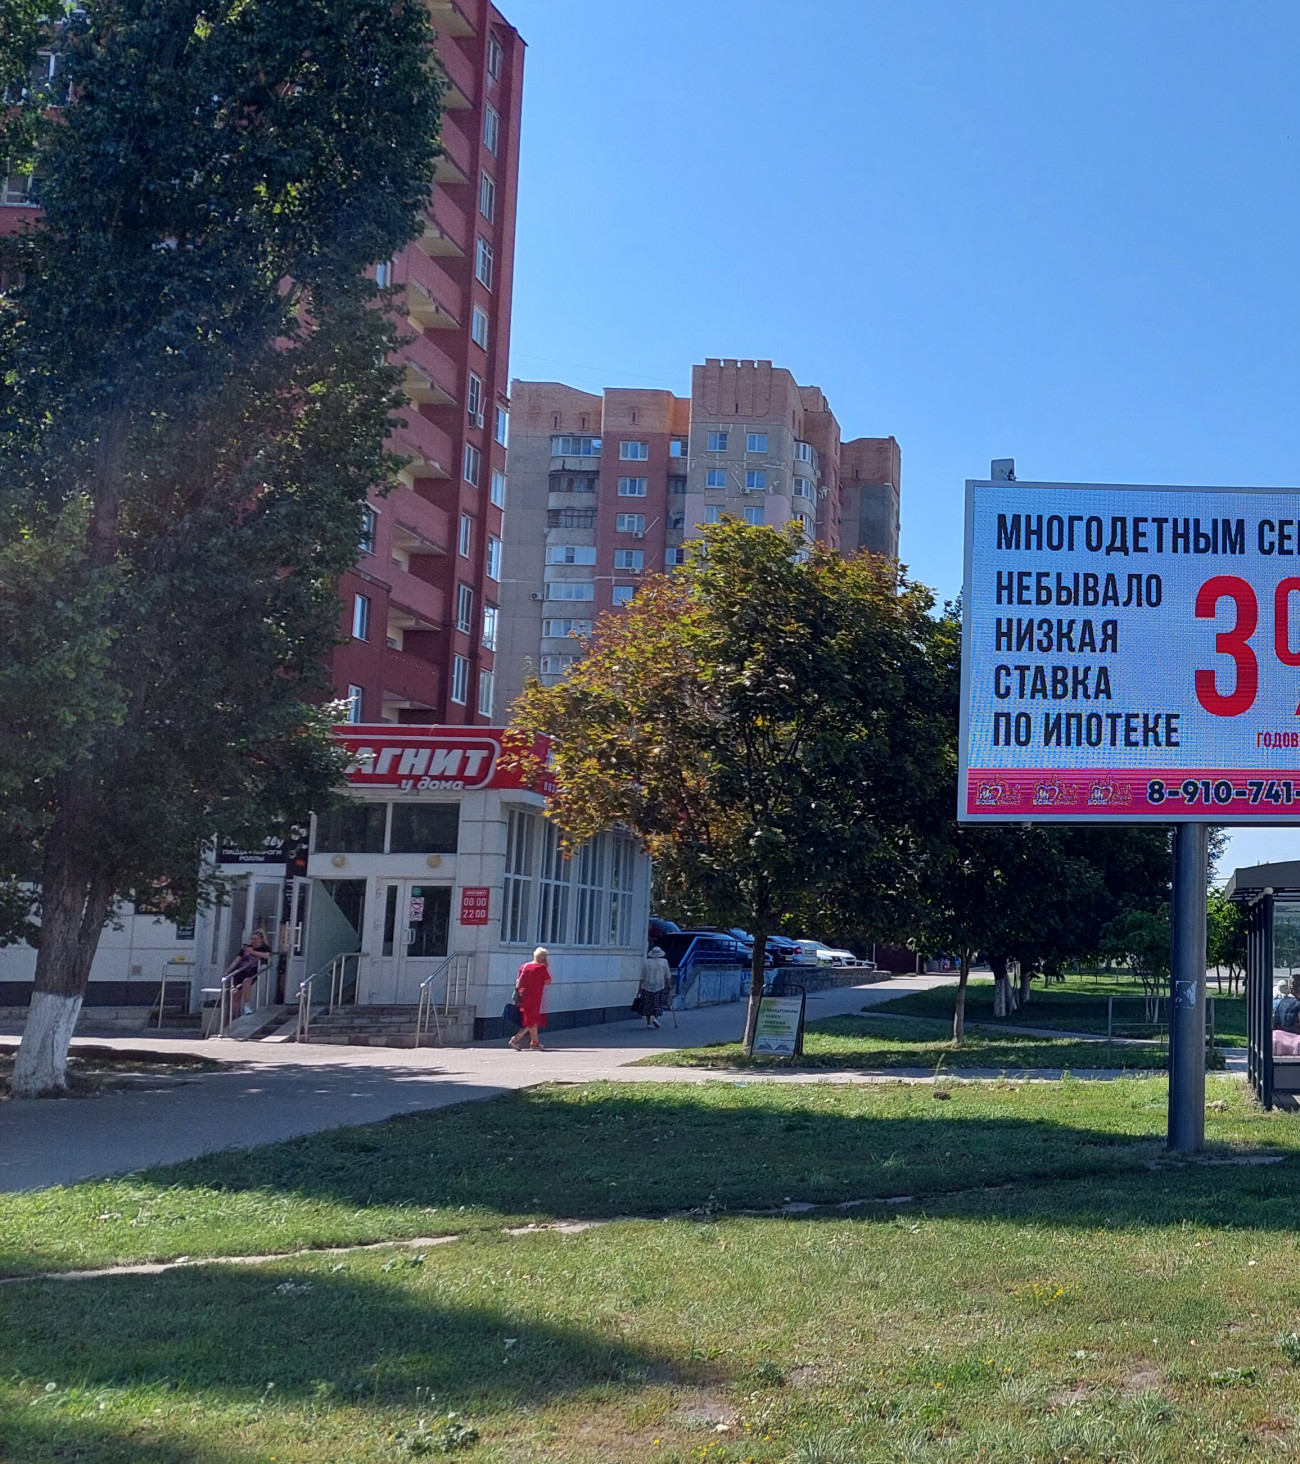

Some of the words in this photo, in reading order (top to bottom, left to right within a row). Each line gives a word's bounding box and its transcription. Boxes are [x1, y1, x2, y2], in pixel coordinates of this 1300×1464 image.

[996, 513, 1245, 556] МНОГОДЕТНЫМ
[996, 571, 1162, 607] НЕБЫВАЛО
[995, 618, 1118, 653] НИЗКАЯ
[994, 664, 1112, 700] СТАВКА
[993, 712, 1032, 747] ПО
[1044, 713, 1180, 748] ИПОТЕКЕ
[345, 747, 489, 777] АГНИТ
[401, 779, 413, 793] у
[417, 776, 464, 791] дома
[463, 909, 474, 918] 22
[475, 909, 486, 918] 00
